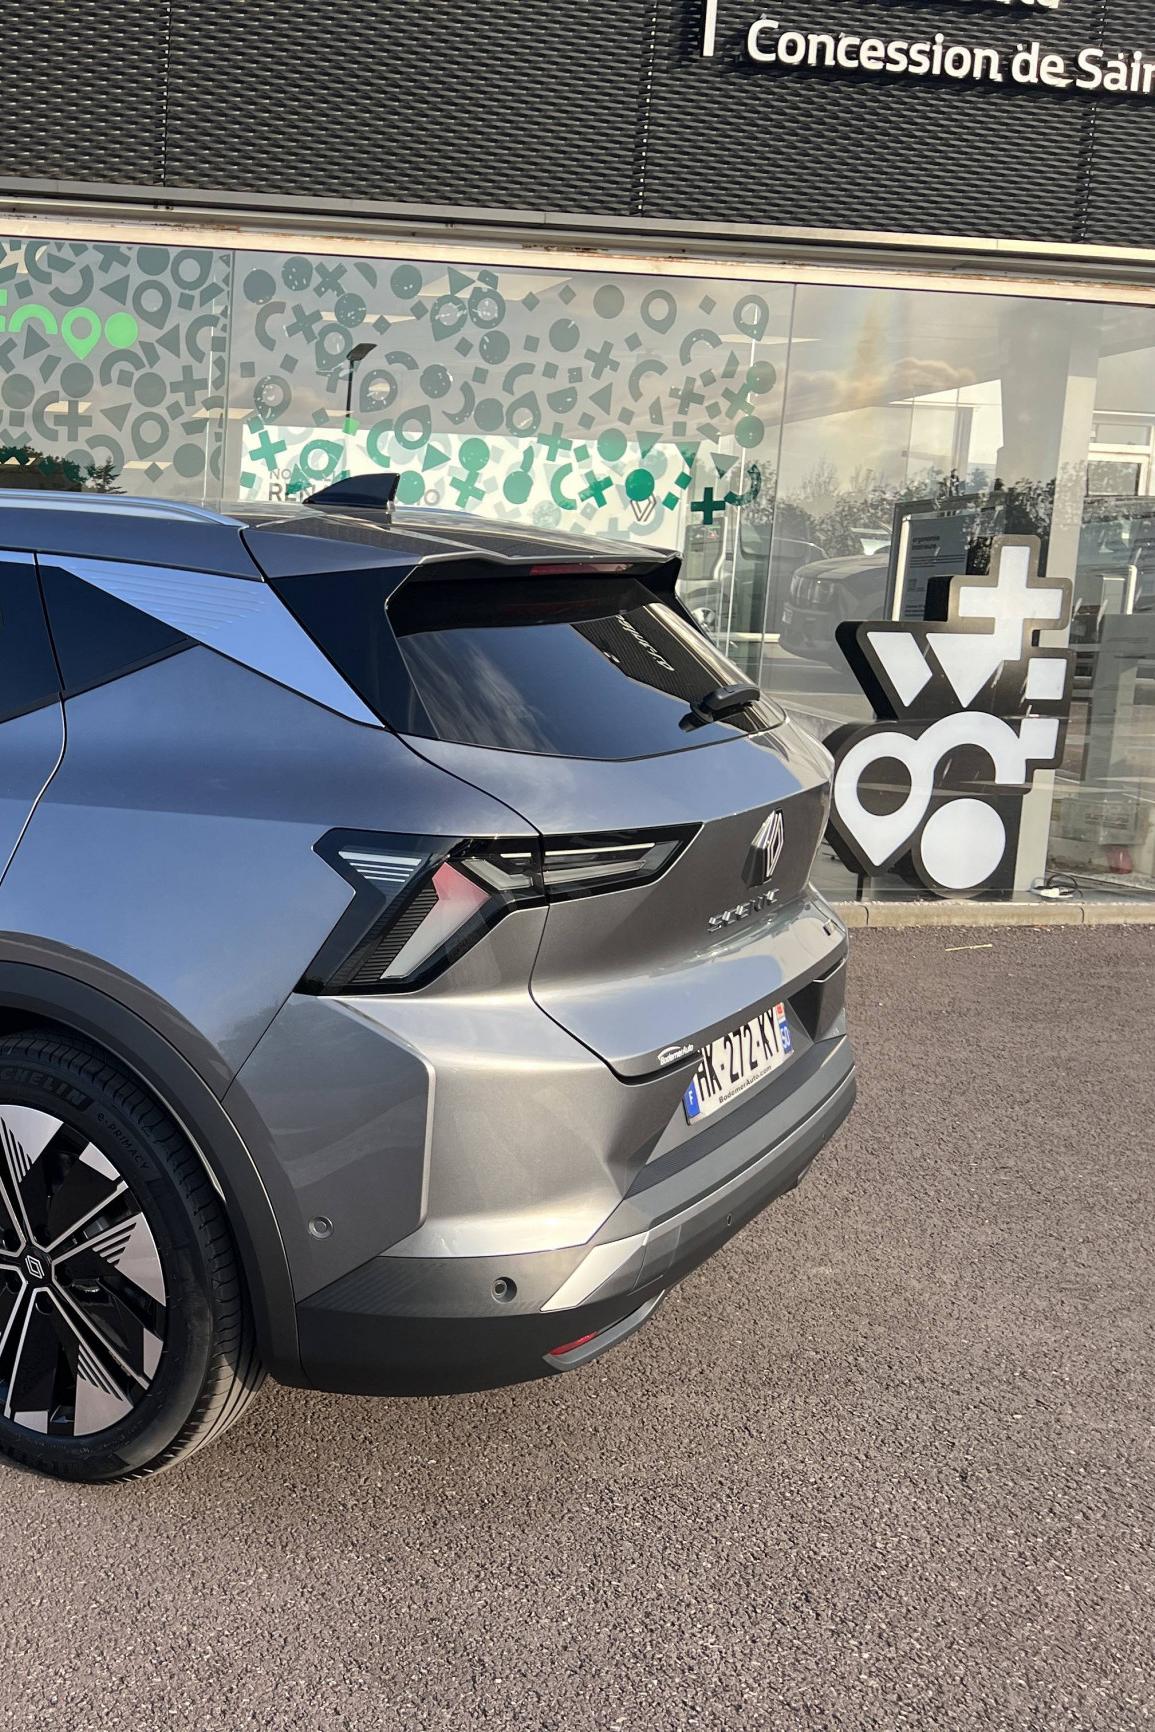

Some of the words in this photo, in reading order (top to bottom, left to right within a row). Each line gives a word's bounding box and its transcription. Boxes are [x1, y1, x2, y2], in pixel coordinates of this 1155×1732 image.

[747, 18, 1002, 82] Concession
[1011, 42, 1065, 86] de
[688, 1090, 694, 1106] F
